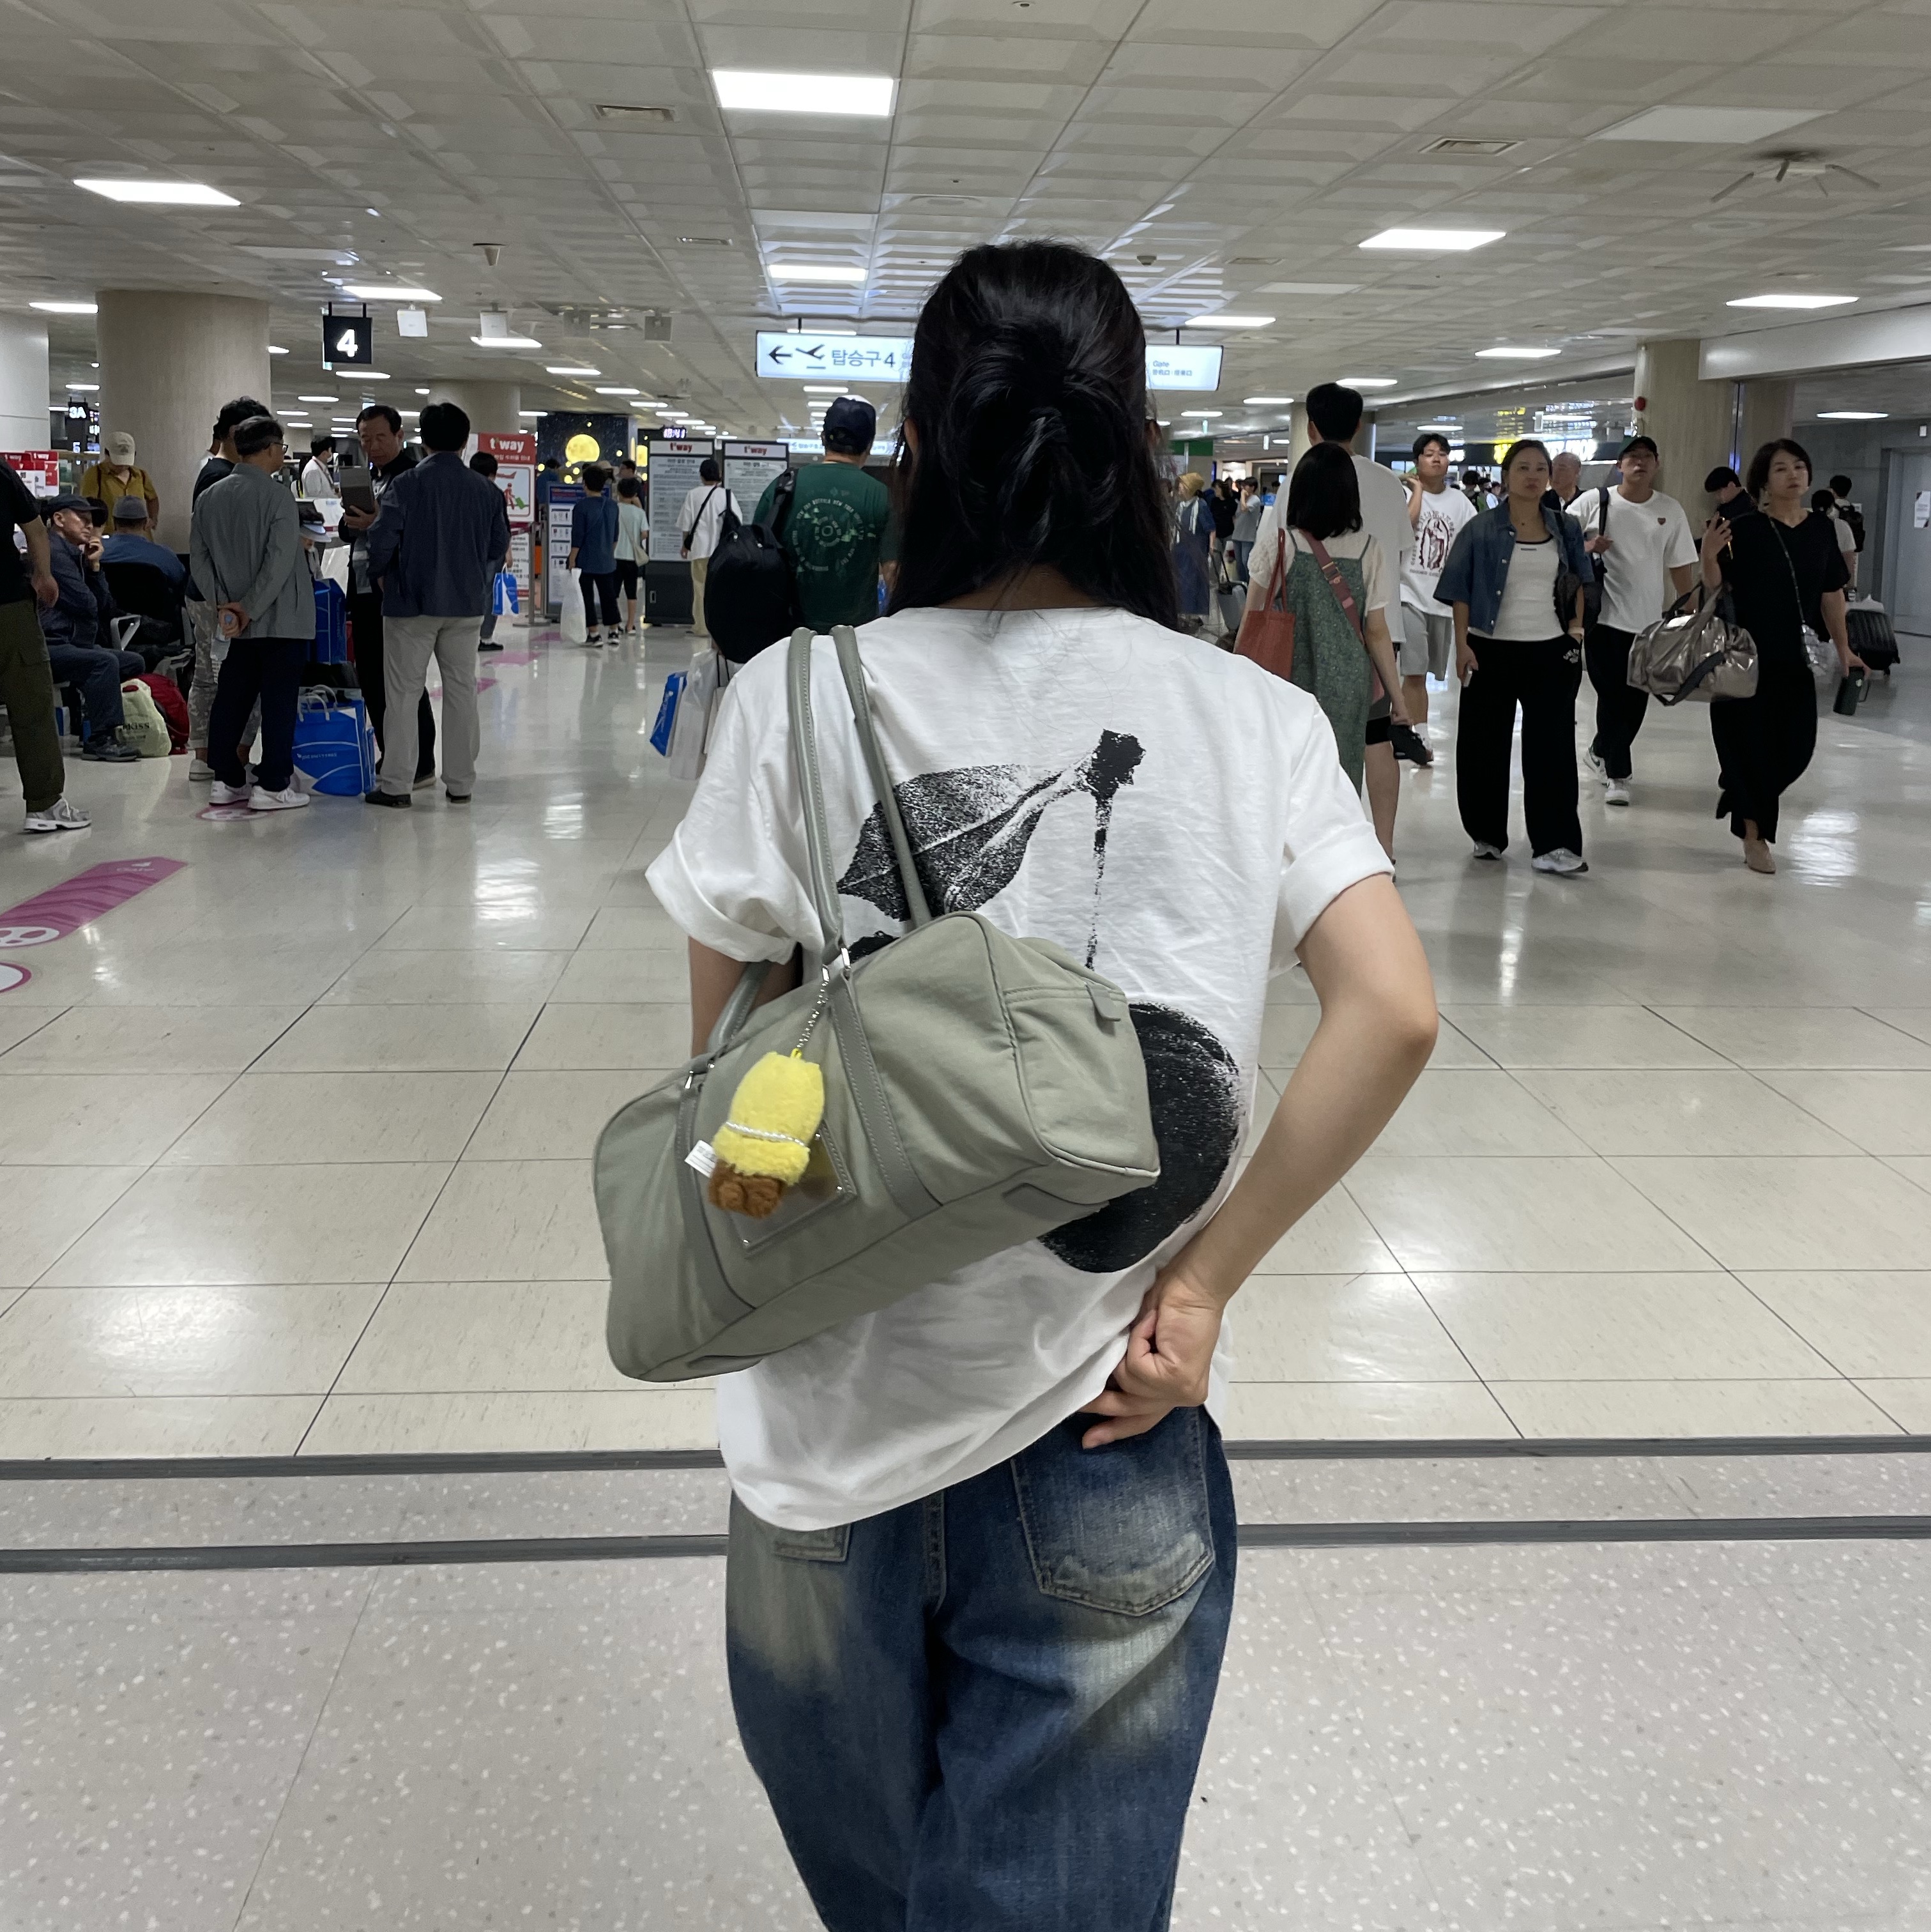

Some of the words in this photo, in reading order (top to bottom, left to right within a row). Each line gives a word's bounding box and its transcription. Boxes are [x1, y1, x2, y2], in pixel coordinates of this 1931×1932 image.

[336, 328, 358, 358] 4
[1152, 360, 1170, 368] Gate
[68, 406, 87, 419] 3A
